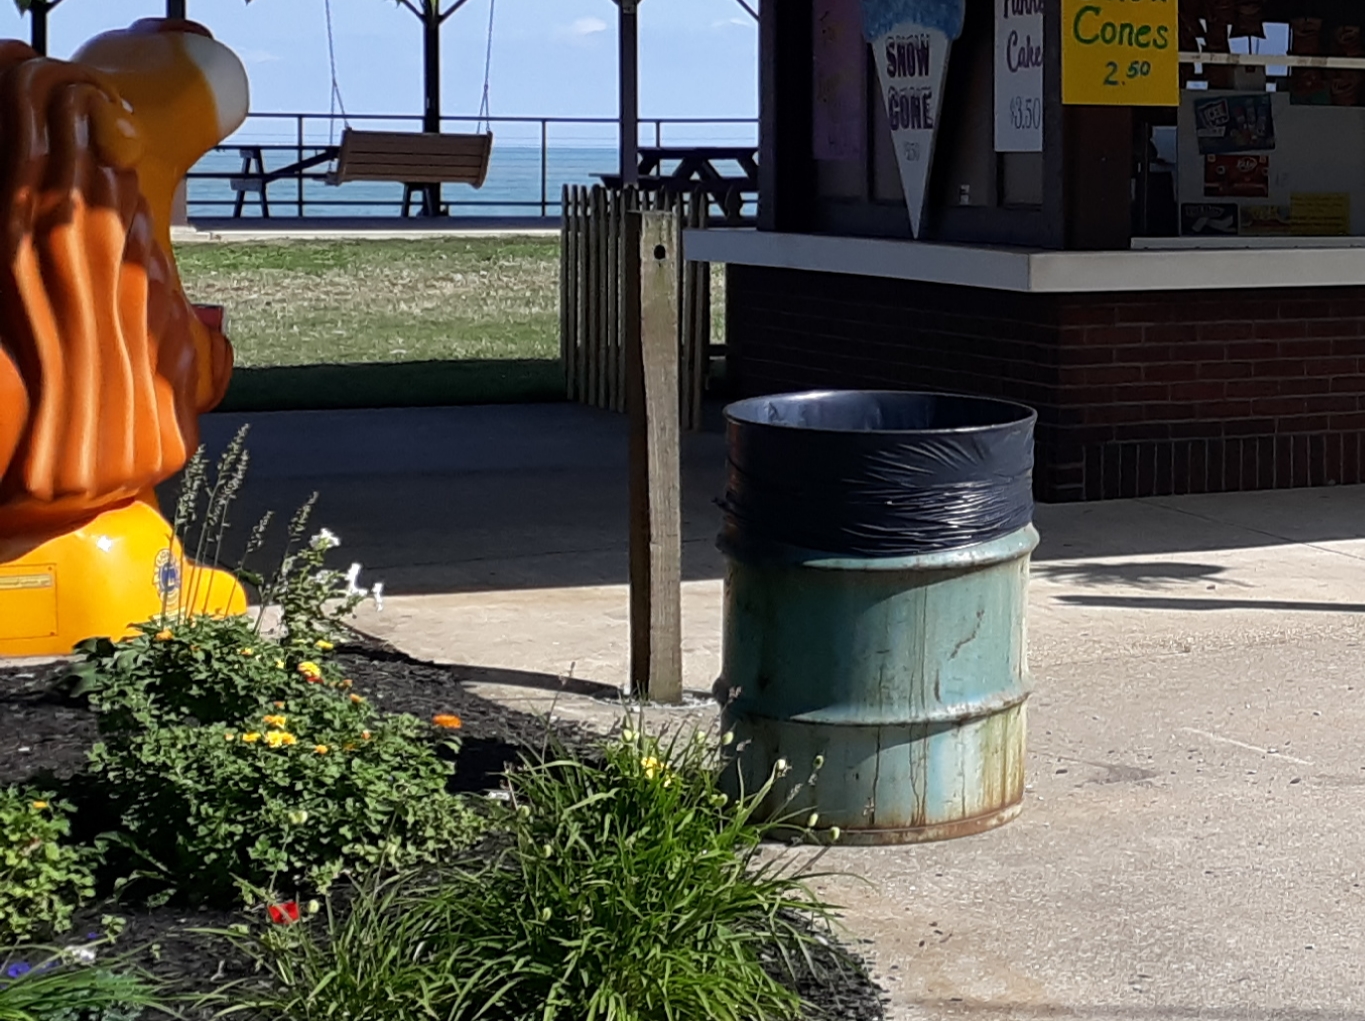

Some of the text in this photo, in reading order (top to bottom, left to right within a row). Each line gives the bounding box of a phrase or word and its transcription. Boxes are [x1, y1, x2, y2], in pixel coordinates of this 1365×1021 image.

[1073, 6, 1169, 50] Cones
[886, 34, 930, 77] SNOW
[1104, 62, 1151, 86] 2.50
[889, 86, 934, 131] CONE
[1010, 96, 1042, 129] $3.50
